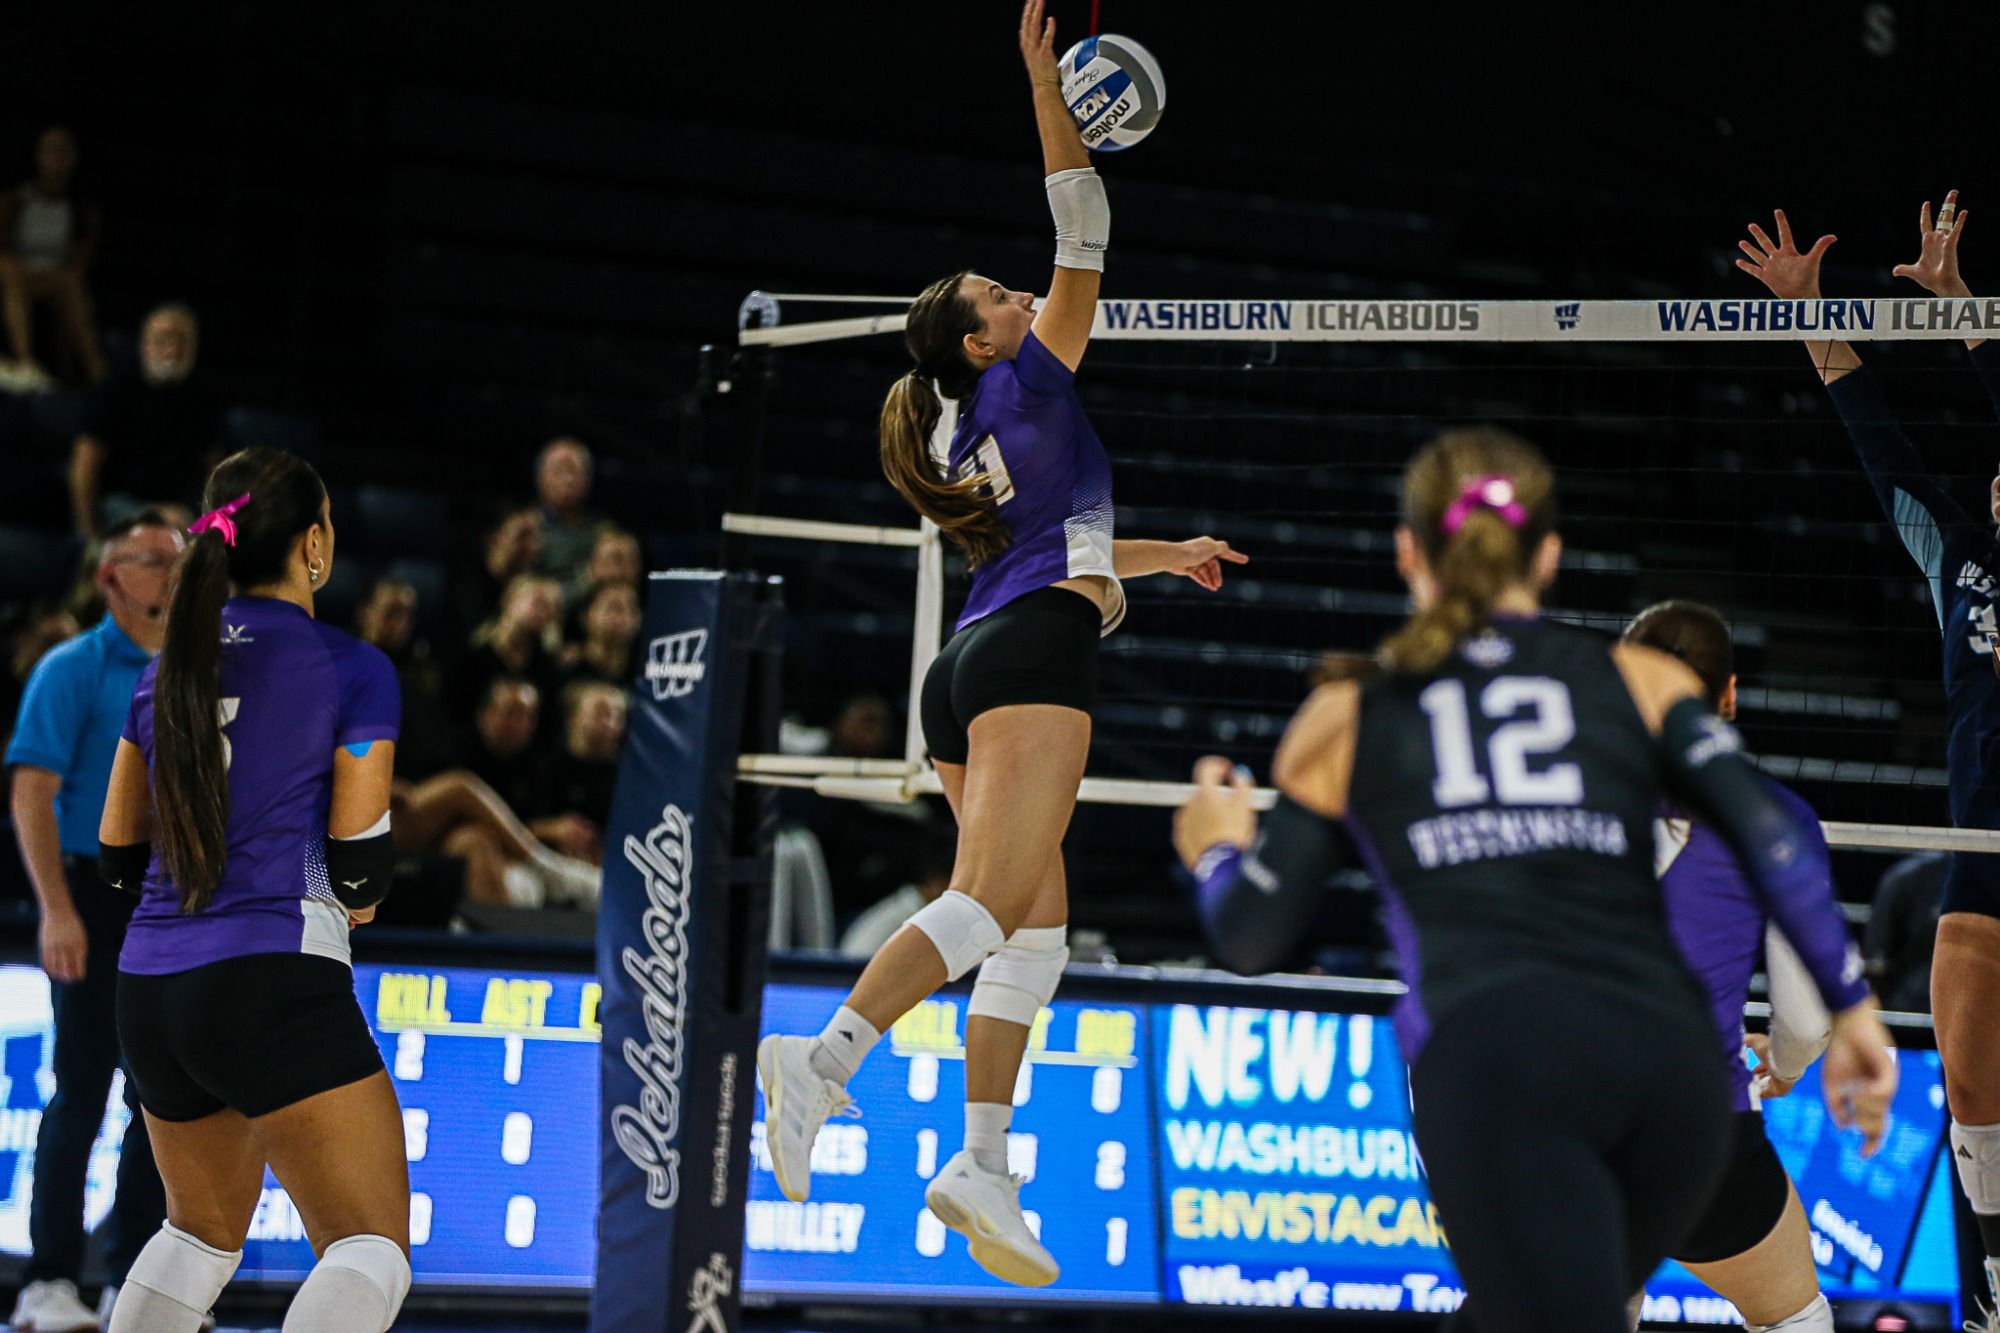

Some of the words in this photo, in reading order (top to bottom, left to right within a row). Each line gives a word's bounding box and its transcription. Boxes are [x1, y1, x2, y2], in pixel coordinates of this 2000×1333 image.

[1082, 98, 1131, 144] molten
[1103, 302, 1292, 331] WASHBURN
[1307, 303, 1480, 332] ICHABODS
[1658, 300, 1876, 331] WASHBURN
[1418, 675, 1585, 808] 12
[482, 978, 552, 1027] AST
[611, 803, 692, 1208] Ichabods
[504, 1033, 523, 1084] 1
[1166, 1003, 1374, 1110] NEW!
[1106, 1218, 1128, 1266] 1
